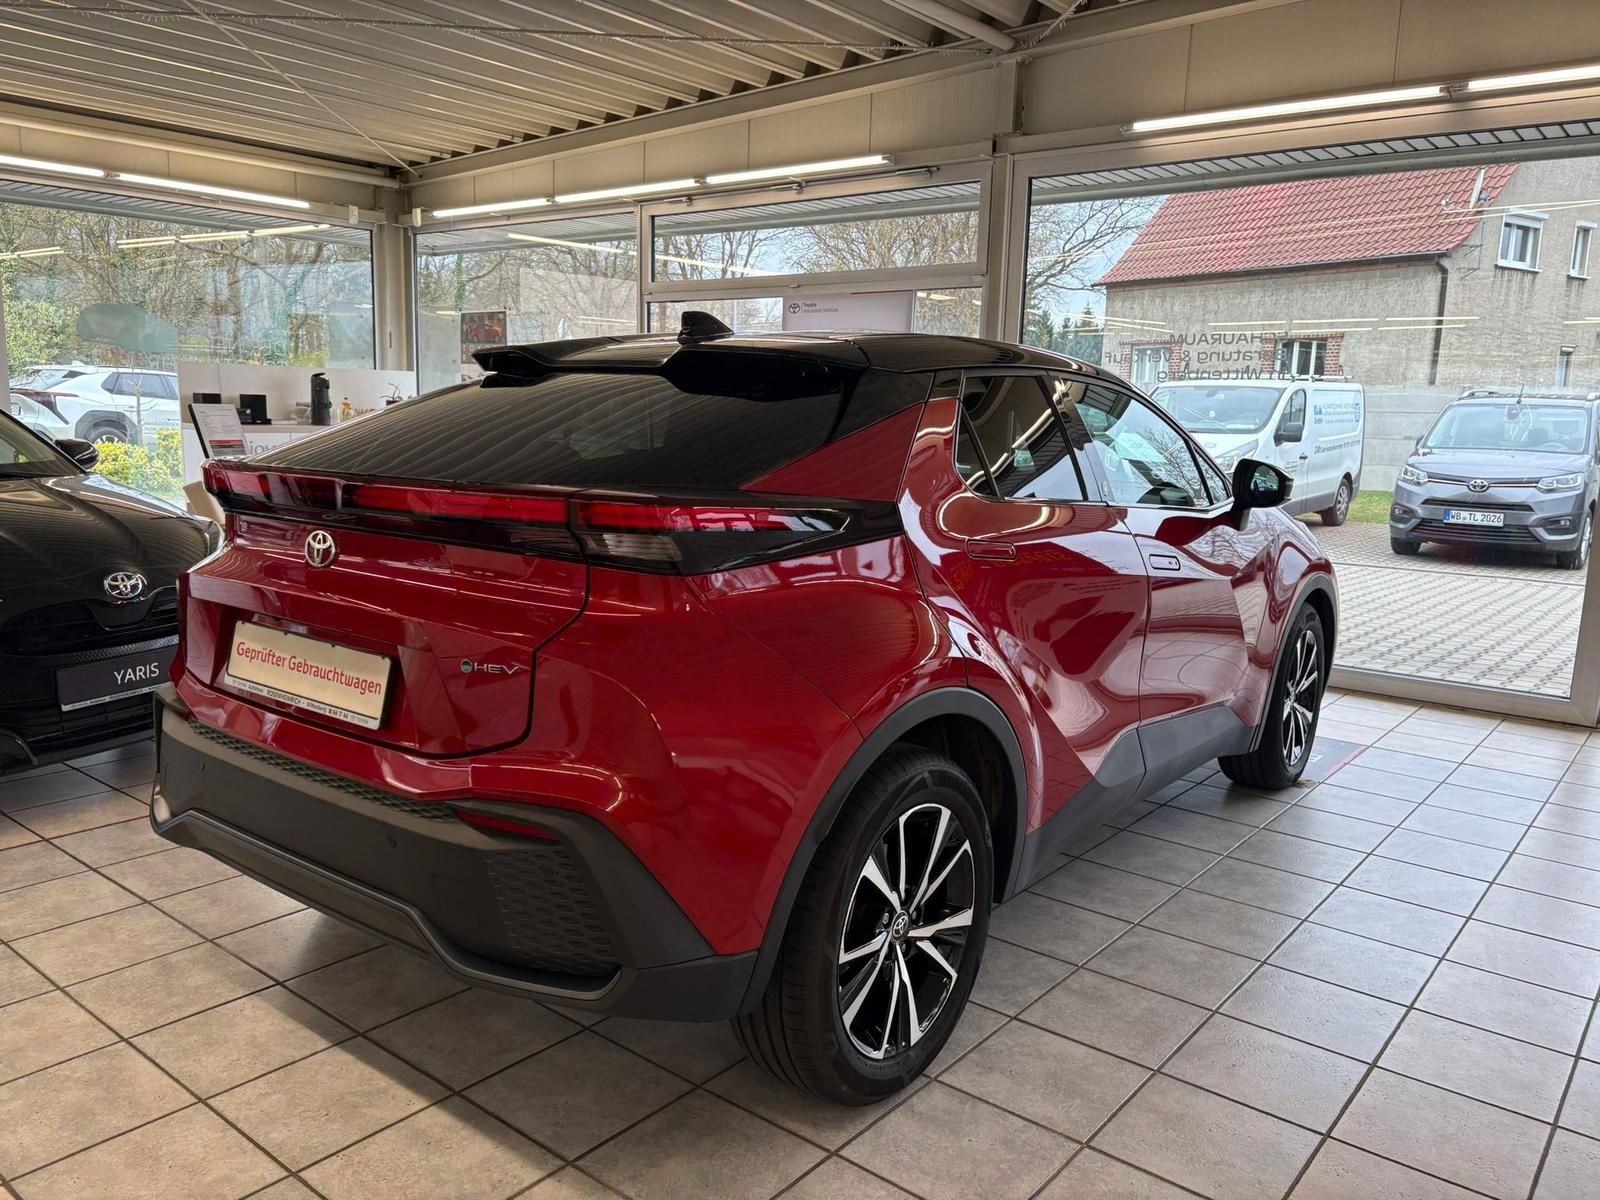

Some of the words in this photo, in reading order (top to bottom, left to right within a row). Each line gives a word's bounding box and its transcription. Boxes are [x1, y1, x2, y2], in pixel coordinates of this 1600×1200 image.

[1450, 511, 1461, 521] WB
[1468, 512, 1479, 521] TL
[1480, 513, 1502, 523] 2026
[113, 662, 160, 685] YARIS
[236, 641, 287, 668] Geprüfter
[288, 655, 382, 695] Gebrauchtwagen
